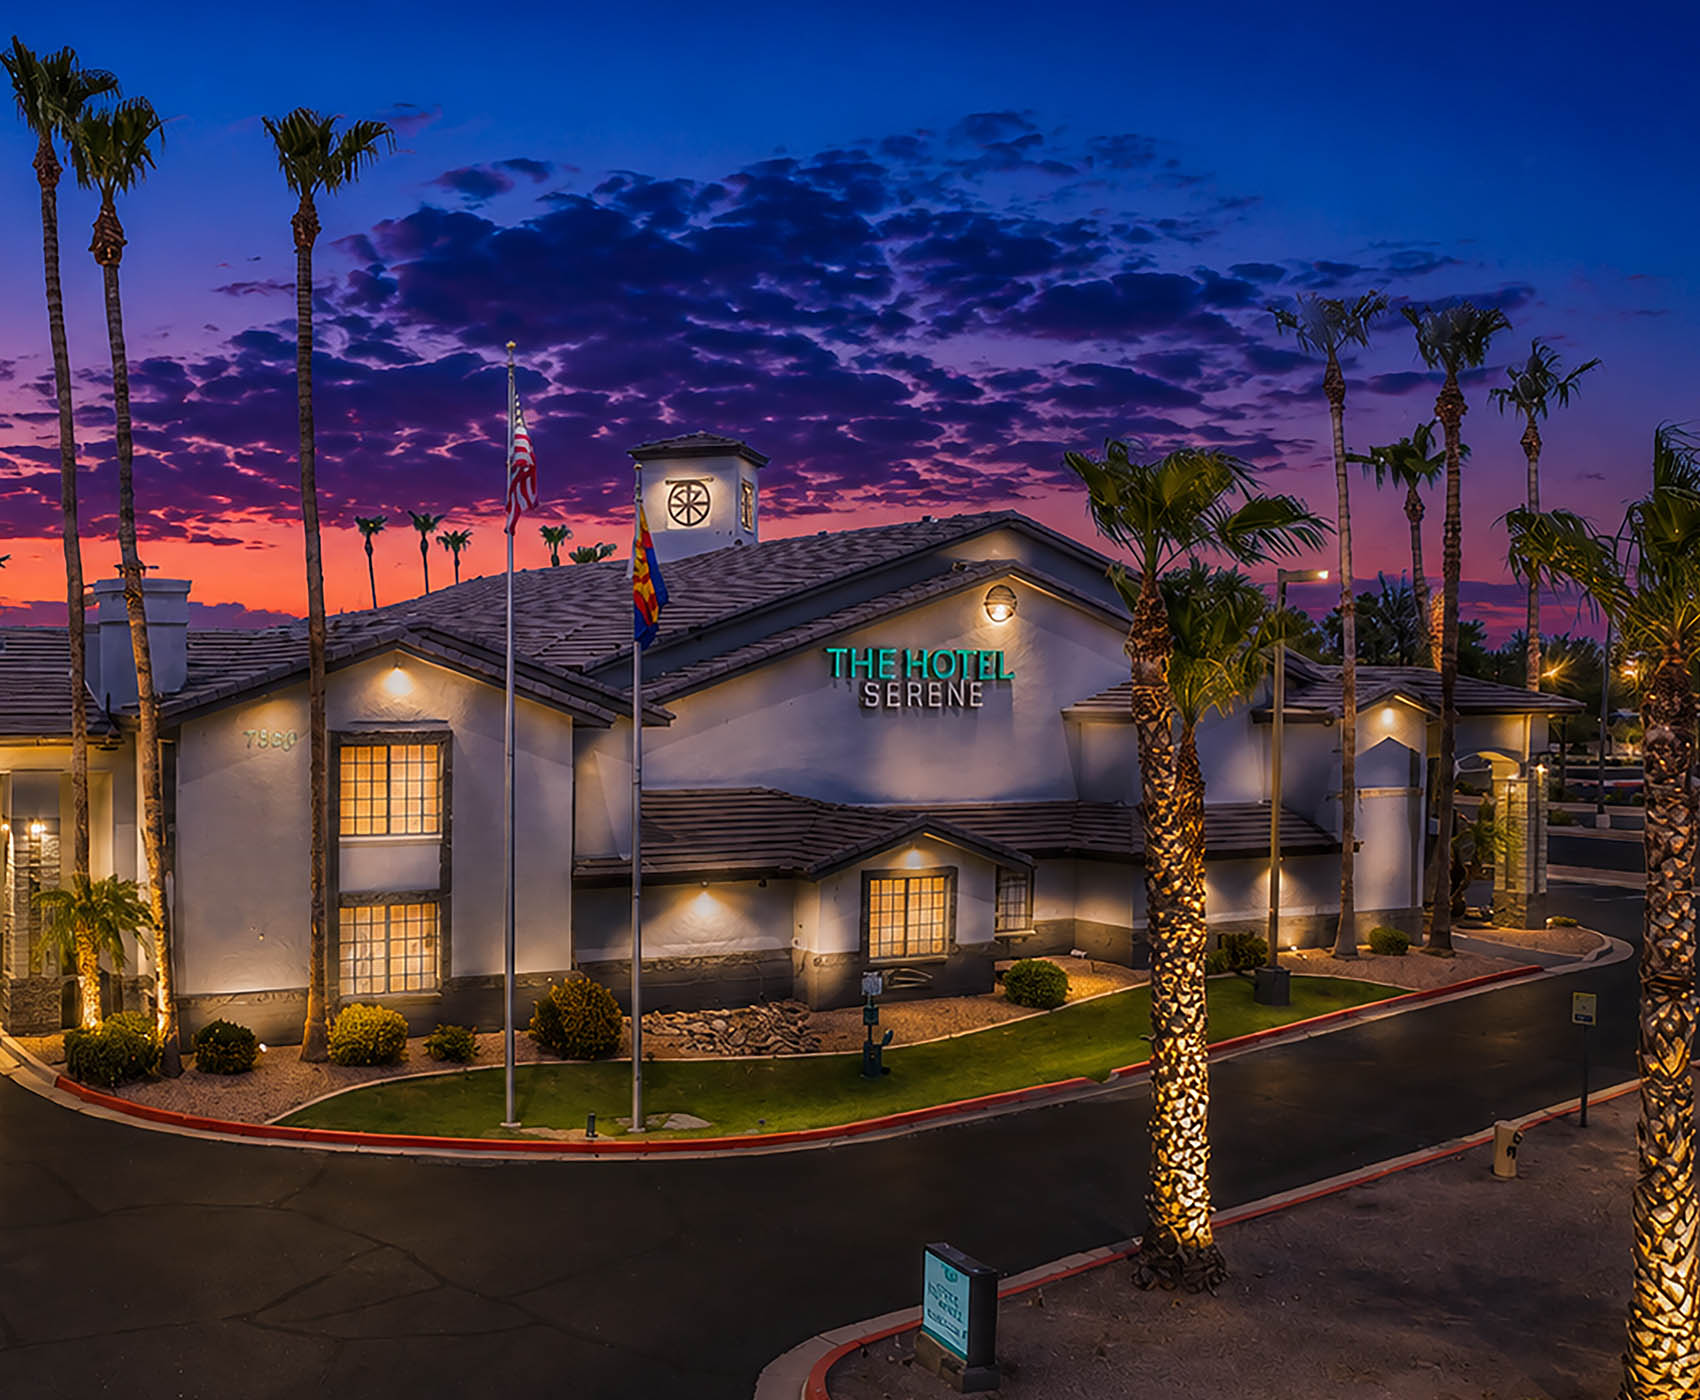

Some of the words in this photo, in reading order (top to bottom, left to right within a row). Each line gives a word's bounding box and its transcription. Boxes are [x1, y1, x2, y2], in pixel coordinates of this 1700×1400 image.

[826, 647, 897, 679] THE
[904, 648, 1015, 679] HOTEL
[863, 681, 984, 707] SERENE
